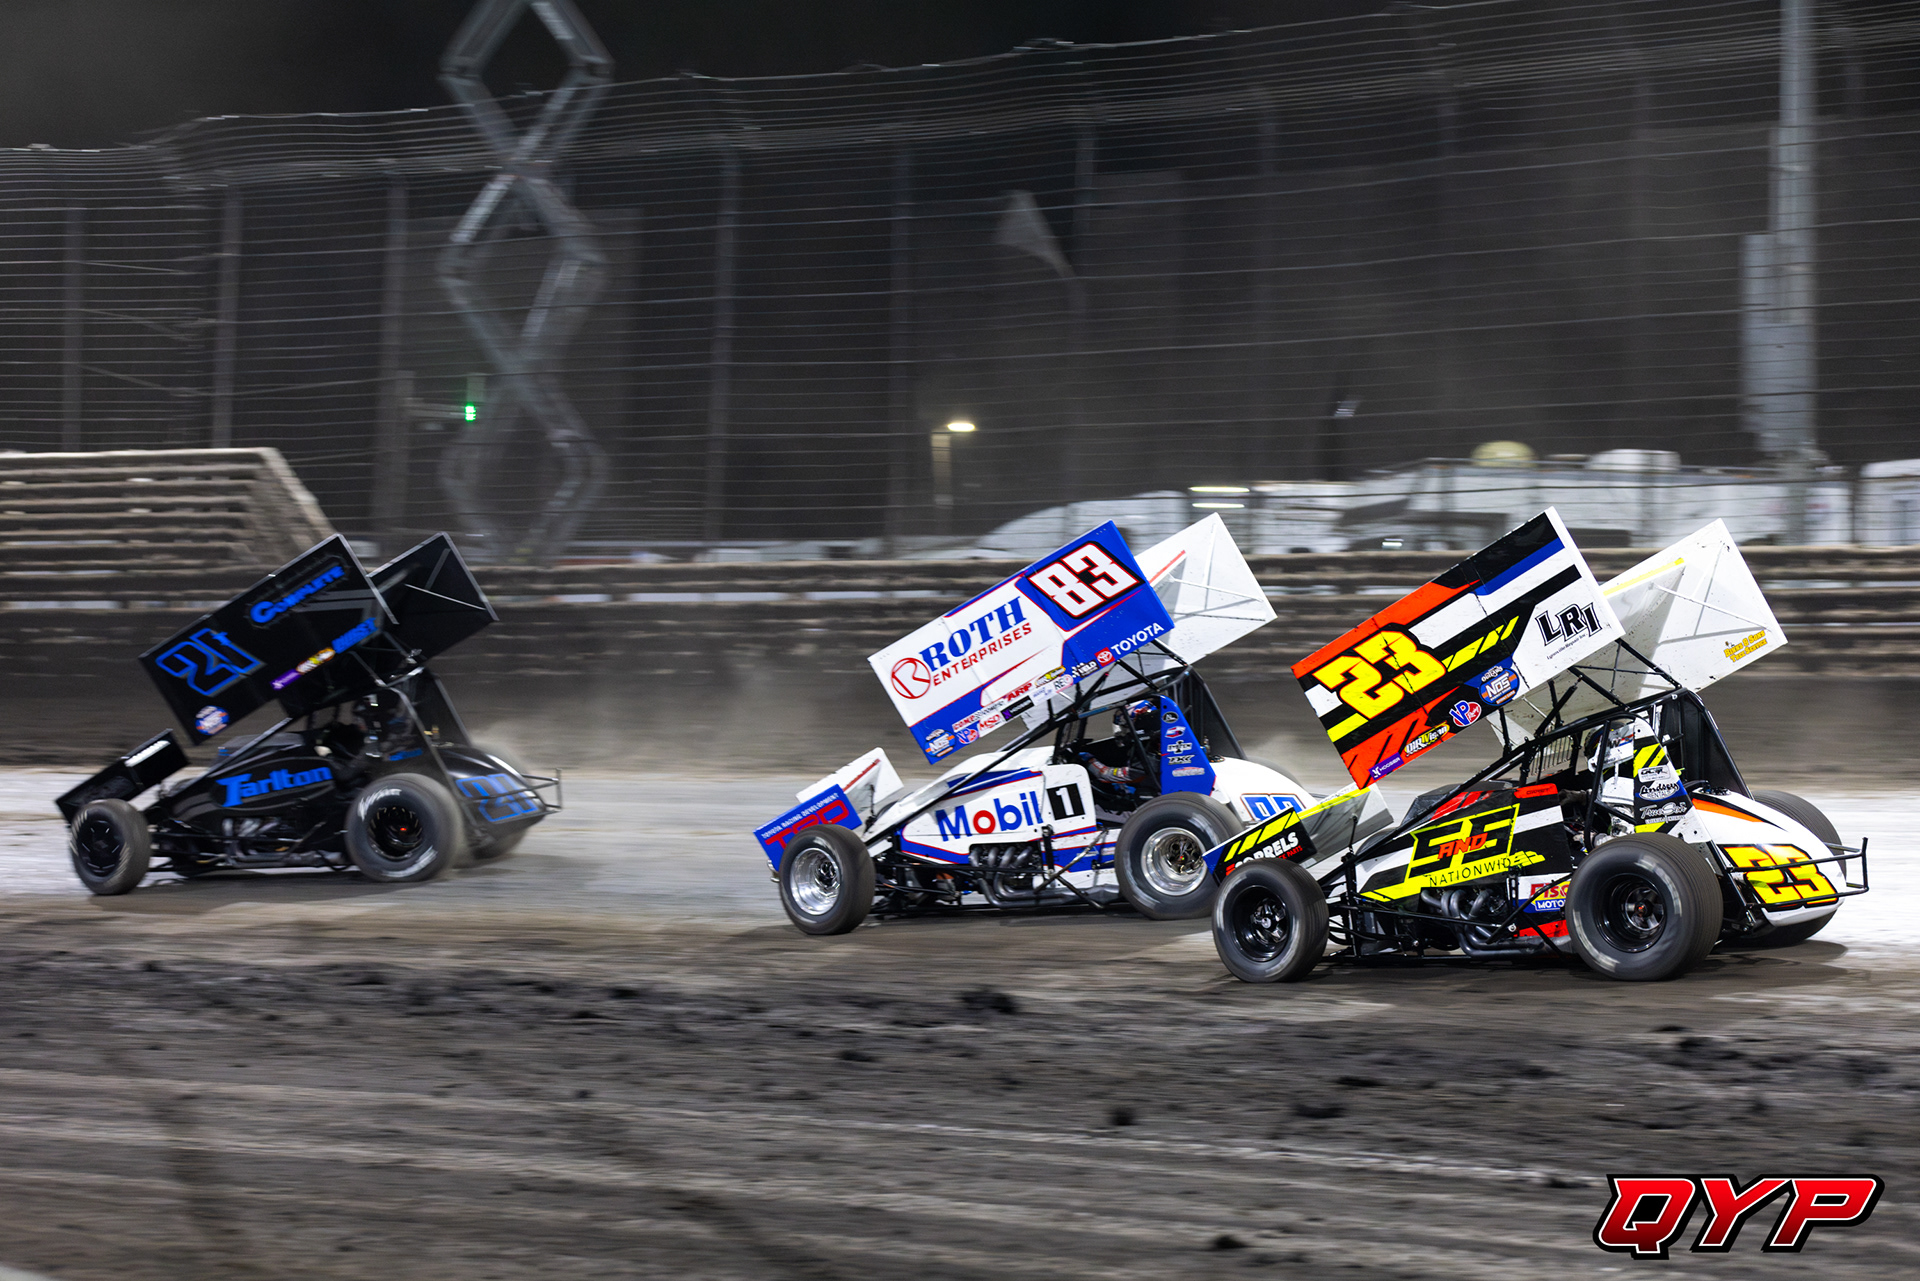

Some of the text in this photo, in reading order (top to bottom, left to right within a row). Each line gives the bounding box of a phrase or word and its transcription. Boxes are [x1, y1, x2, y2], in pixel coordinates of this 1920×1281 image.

[1027, 542, 1140, 618] 83
[919, 596, 1027, 673] ROTH
[1111, 622, 1165, 655] TOYOTA
[1534, 601, 1603, 647] LRI
[932, 622, 1033, 687] ENTERPRISES
[1312, 630, 1447, 720] 23
[1007, 682, 1033, 702] ARP
[1485, 671, 1510, 698] NOS
[1449, 700, 1470, 726] VP
[215, 766, 334, 808] Tarlton
[935, 786, 1076, 843] Mobil 1
[1235, 831, 1300, 868] RRELS
[1437, 832, 1489, 860] AND
[1723, 844, 1839, 908] 23
